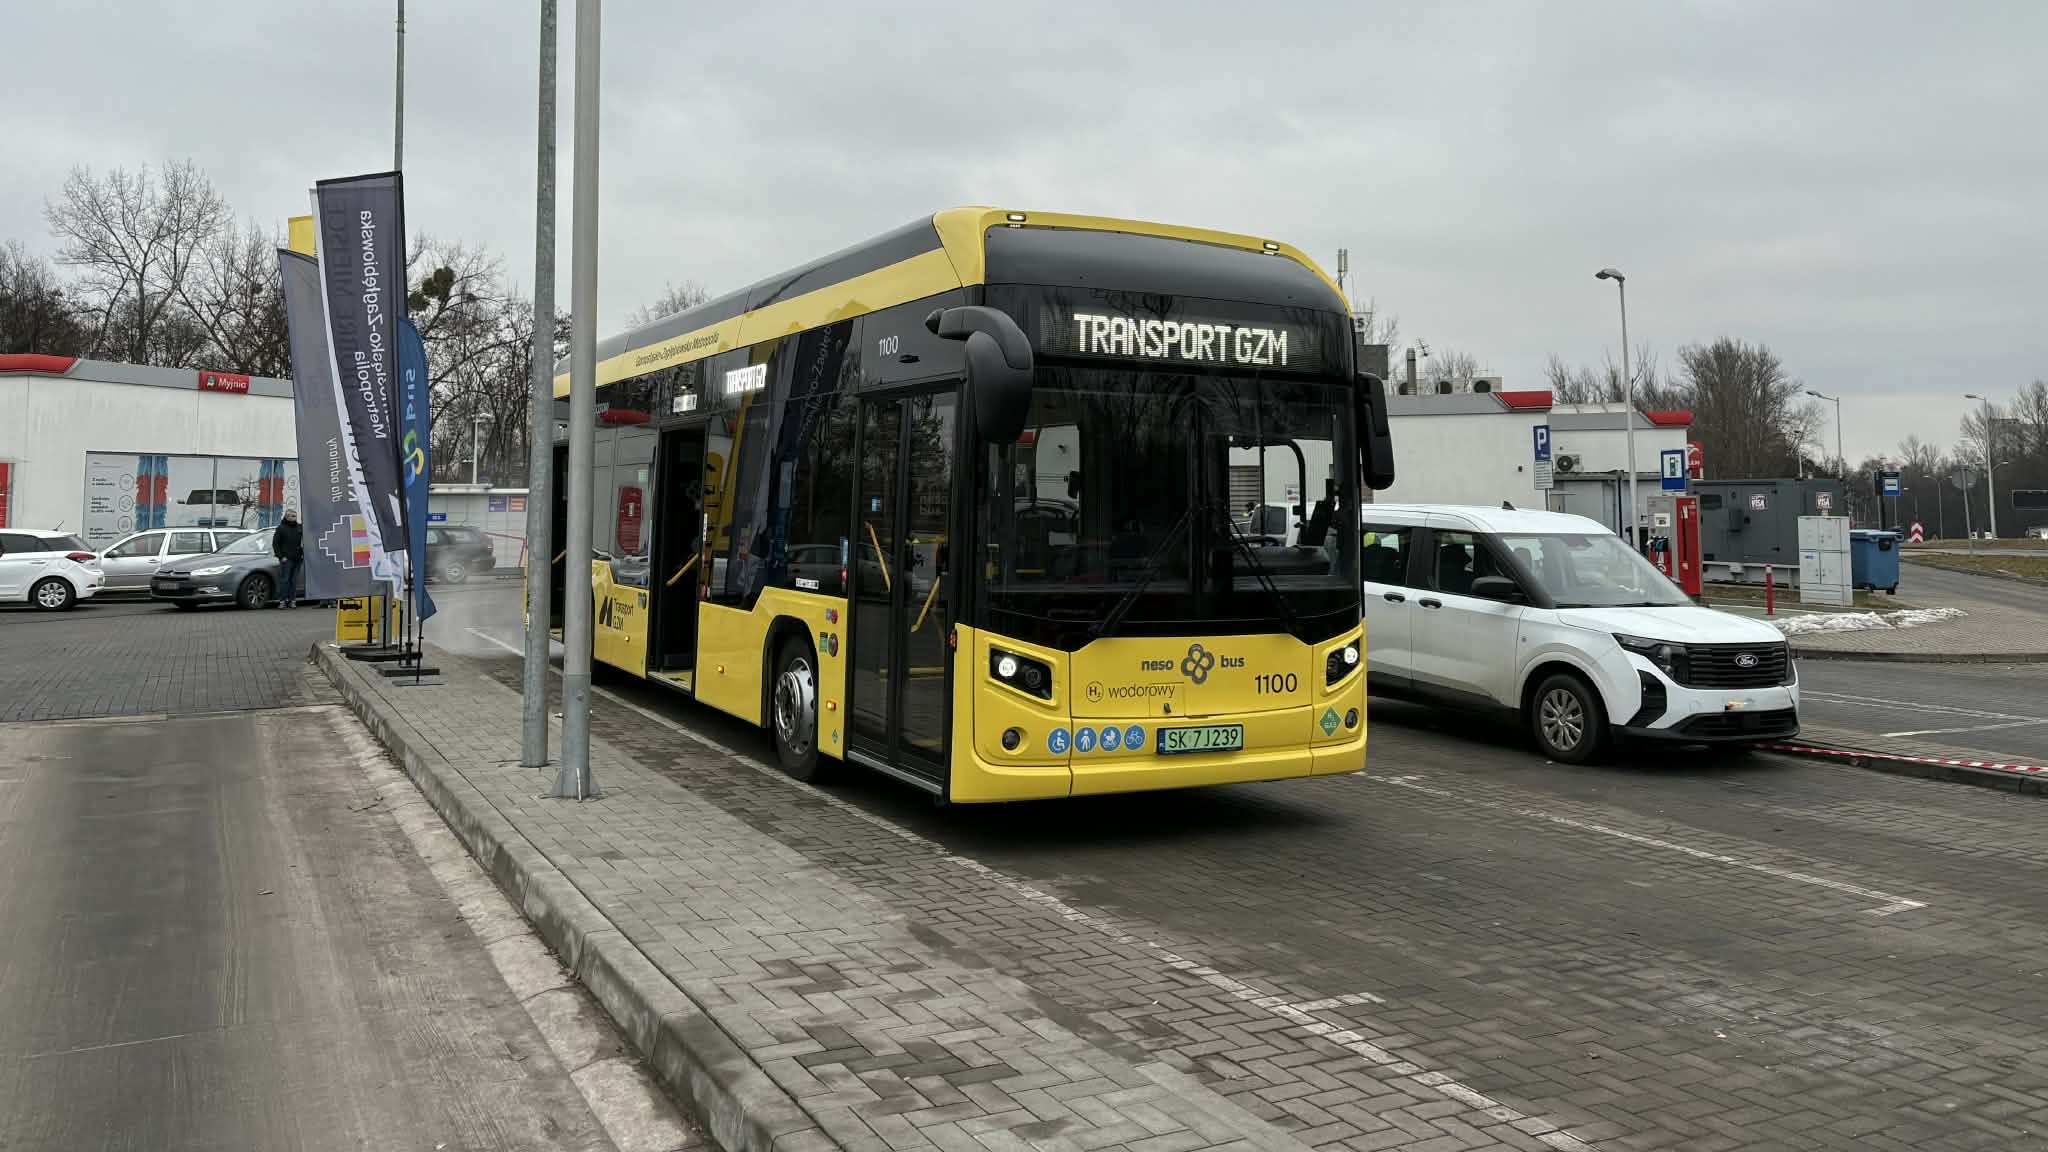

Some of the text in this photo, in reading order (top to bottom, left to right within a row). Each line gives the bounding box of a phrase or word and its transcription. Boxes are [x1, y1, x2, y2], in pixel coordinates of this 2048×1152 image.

[879, 336, 898, 356] 1100
[1074, 314, 1287, 366] TRANSPORT GZM
[217, 377, 247, 390] Myjnia
[1538, 429, 1547, 450] P
[1141, 656, 1245, 671] neso bus
[1108, 683, 1176, 698] wodorowy
[1254, 673, 1298, 694] 1100
[1168, 730, 1187, 748] SK
